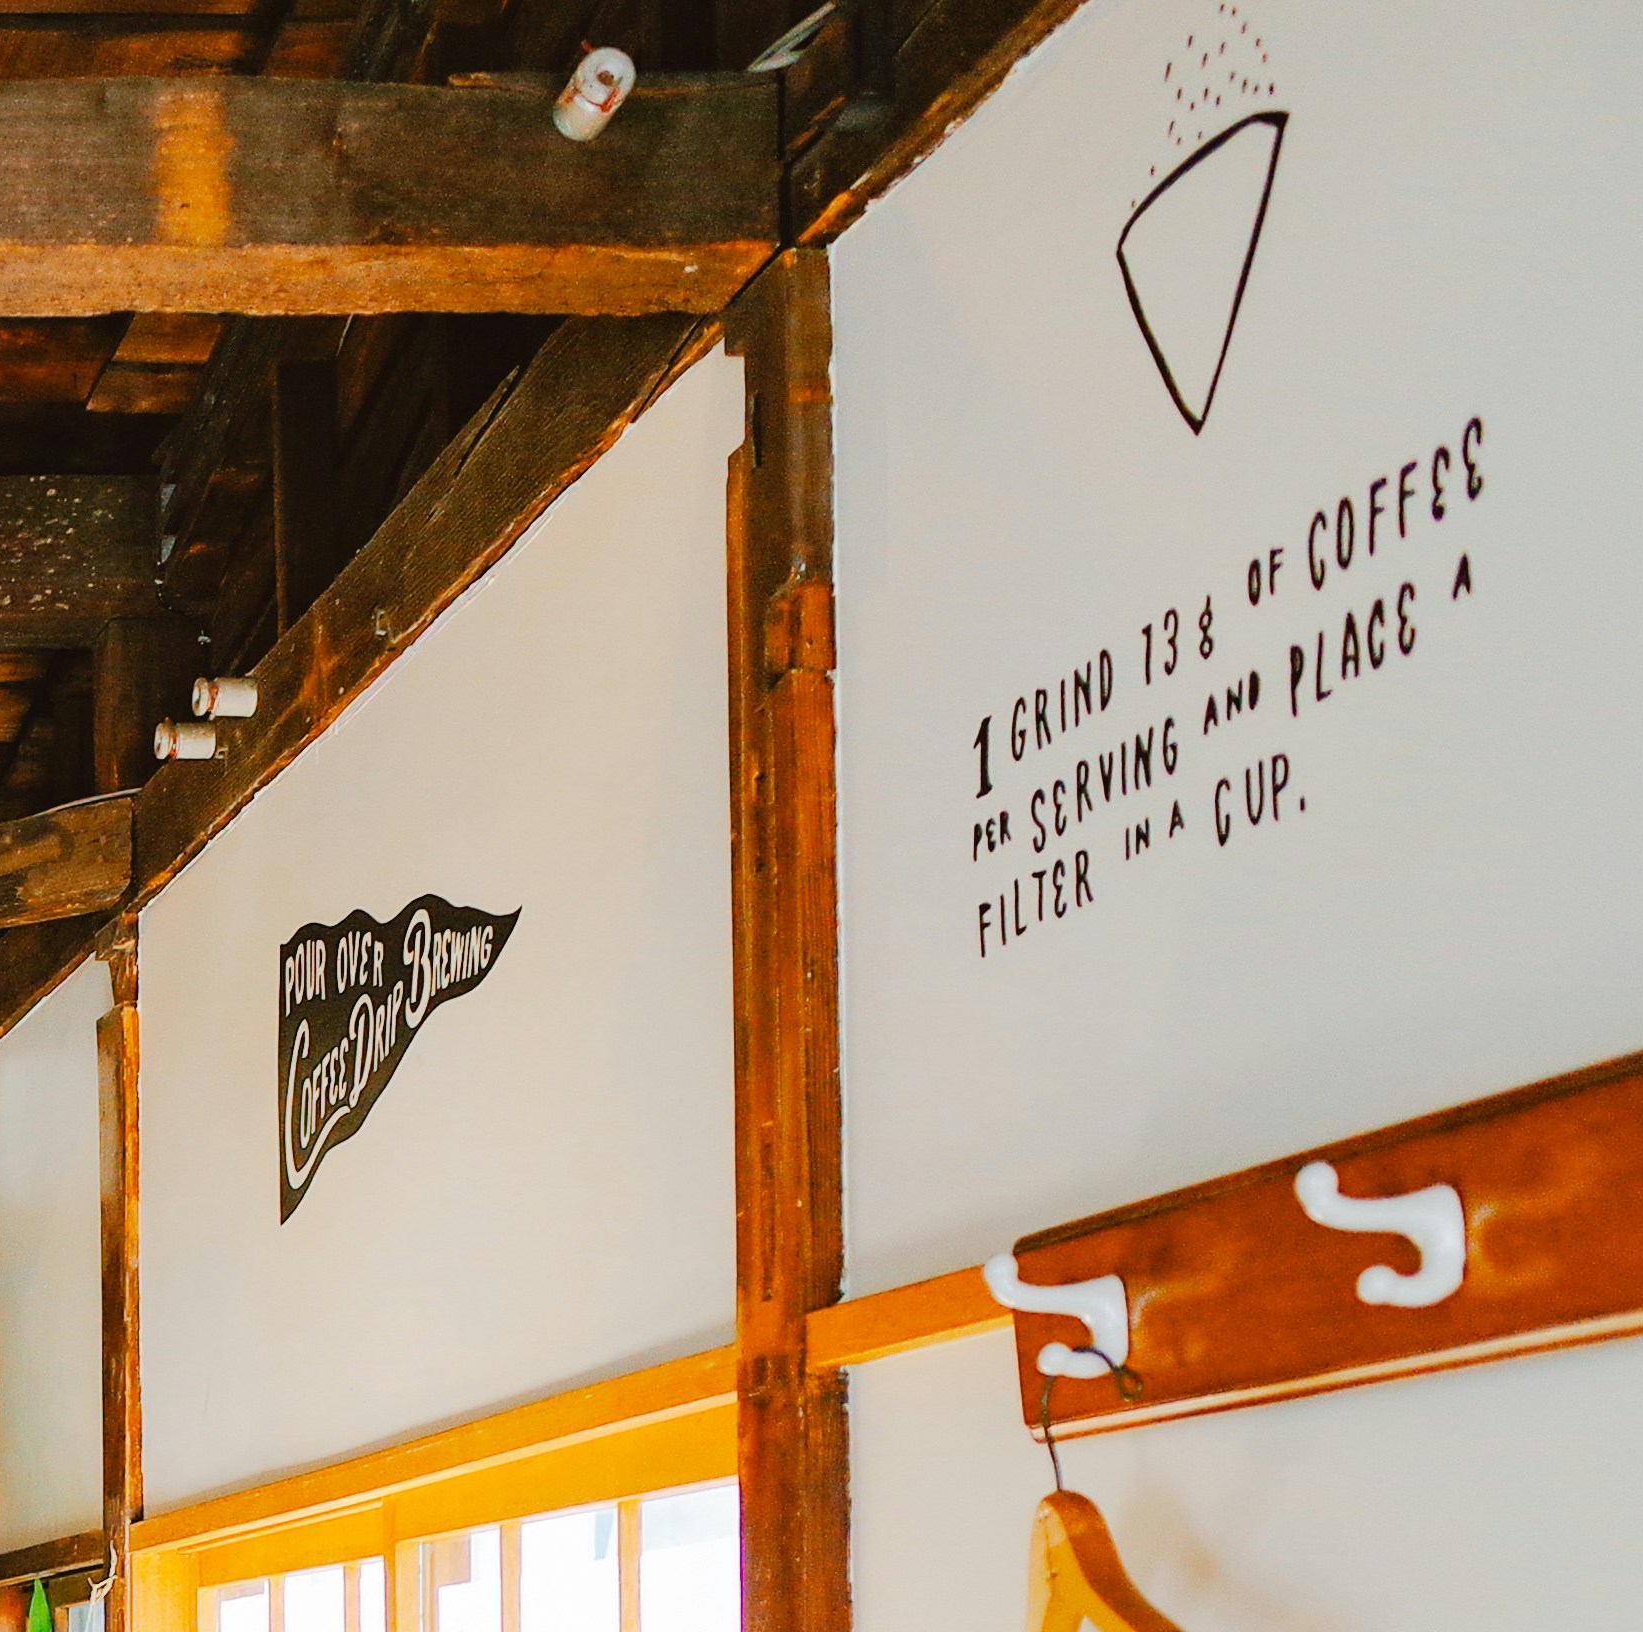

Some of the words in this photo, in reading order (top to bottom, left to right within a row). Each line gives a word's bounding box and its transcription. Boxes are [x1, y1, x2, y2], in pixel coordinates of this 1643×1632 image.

[1011, 649, 1114, 762] GRIND
[1248, 549, 1284, 606] OF
[1308, 418, 1483, 591] COFFEE
[974, 811, 1012, 861] PER
[1031, 717, 1178, 853] SERVING
[1204, 671, 1261, 735] AND
[1289, 582, 1416, 718] PLACE
[1452, 553, 1472, 600] A
[979, 850, 1094, 958] FILTER
[1126, 818, 1150, 861] IN
[1169, 801, 1185, 838] A
[1215, 753, 1306, 848] CUP.
[285, 940, 326, 1017] POUR
[337, 931, 384, 987] OVER
[349, 981, 404, 1109] DRIP
[403, 908, 494, 1029] BREWING
